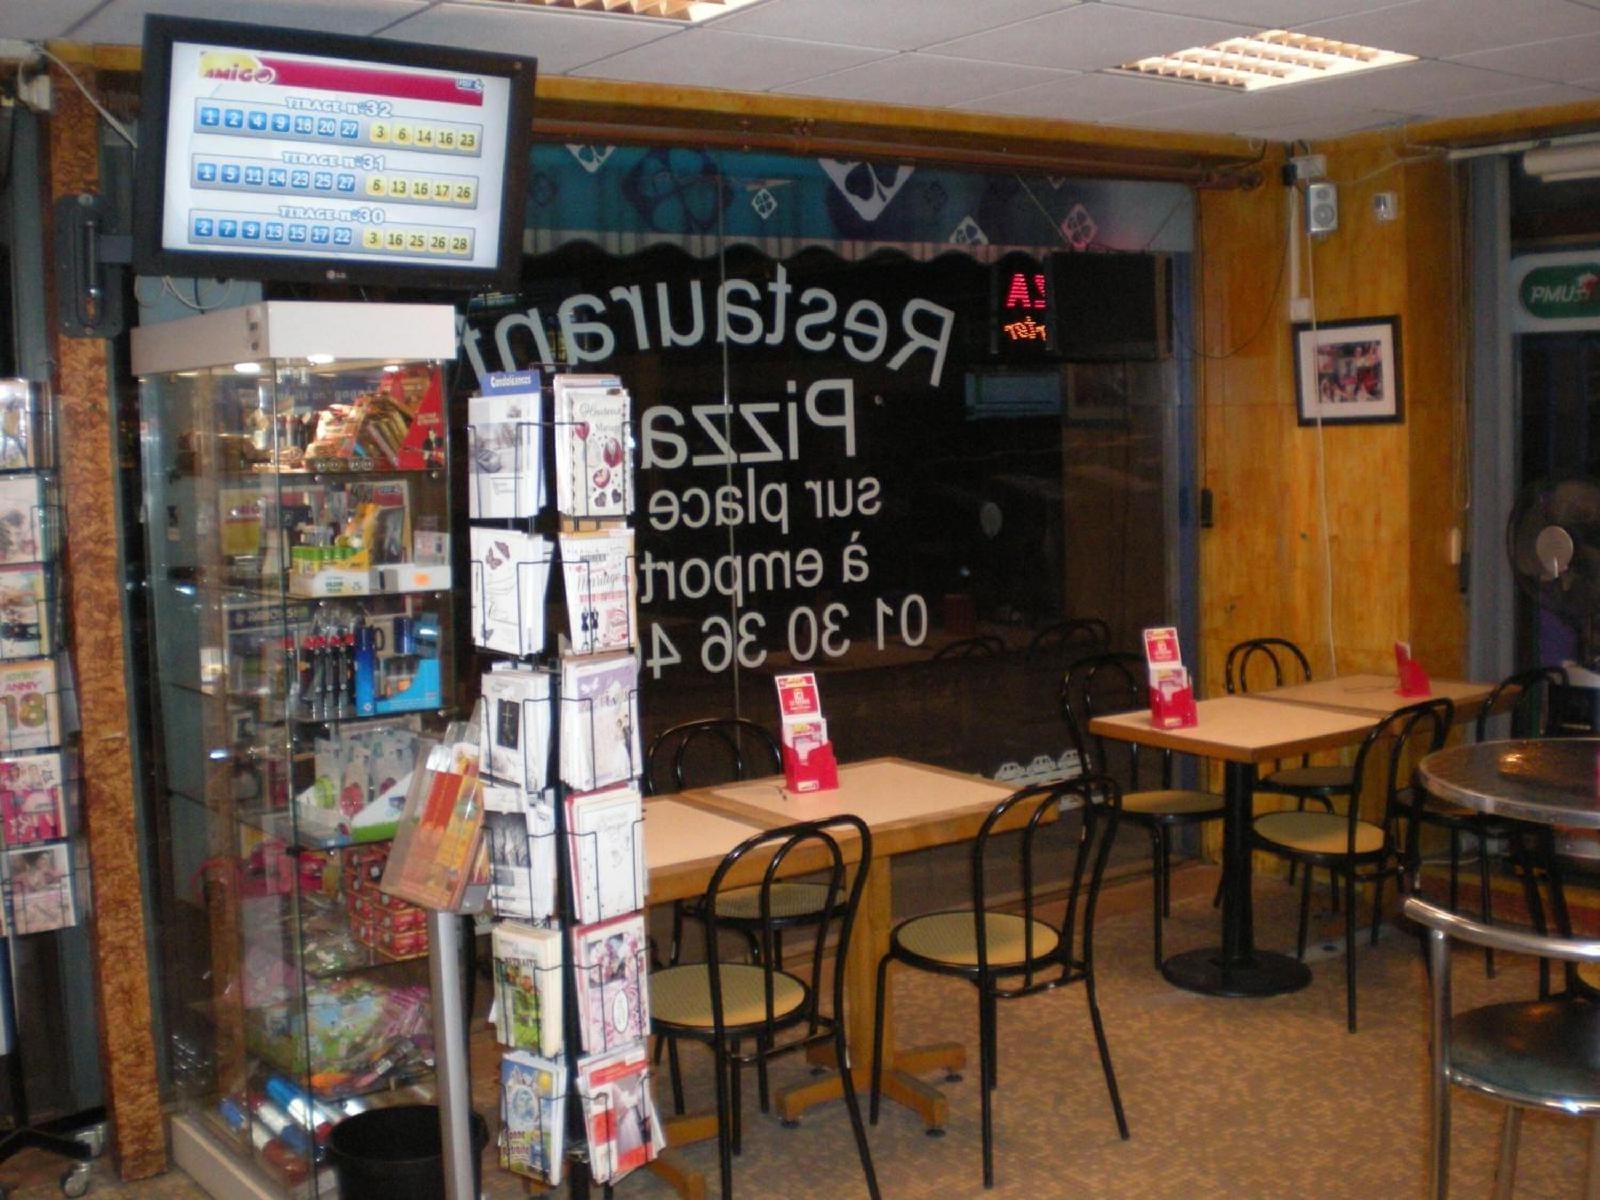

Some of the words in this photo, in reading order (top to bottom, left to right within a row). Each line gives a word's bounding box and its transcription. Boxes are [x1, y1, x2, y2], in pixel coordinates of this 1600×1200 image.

[342, 121, 357, 136] 27
[417, 130, 432, 142] 14
[439, 132, 453, 144] 16
[460, 134, 475, 146] 23
[393, 181, 406, 193] 13
[414, 182, 428, 195] 16
[436, 184, 449, 197] 17
[456, 186, 471, 198] 26
[388, 234, 403, 246] 16
[409, 235, 424, 247] 25
[431, 236, 446, 248] 26
[452, 238, 467, 250] 28
[1530, 285, 1575, 303] PMU
